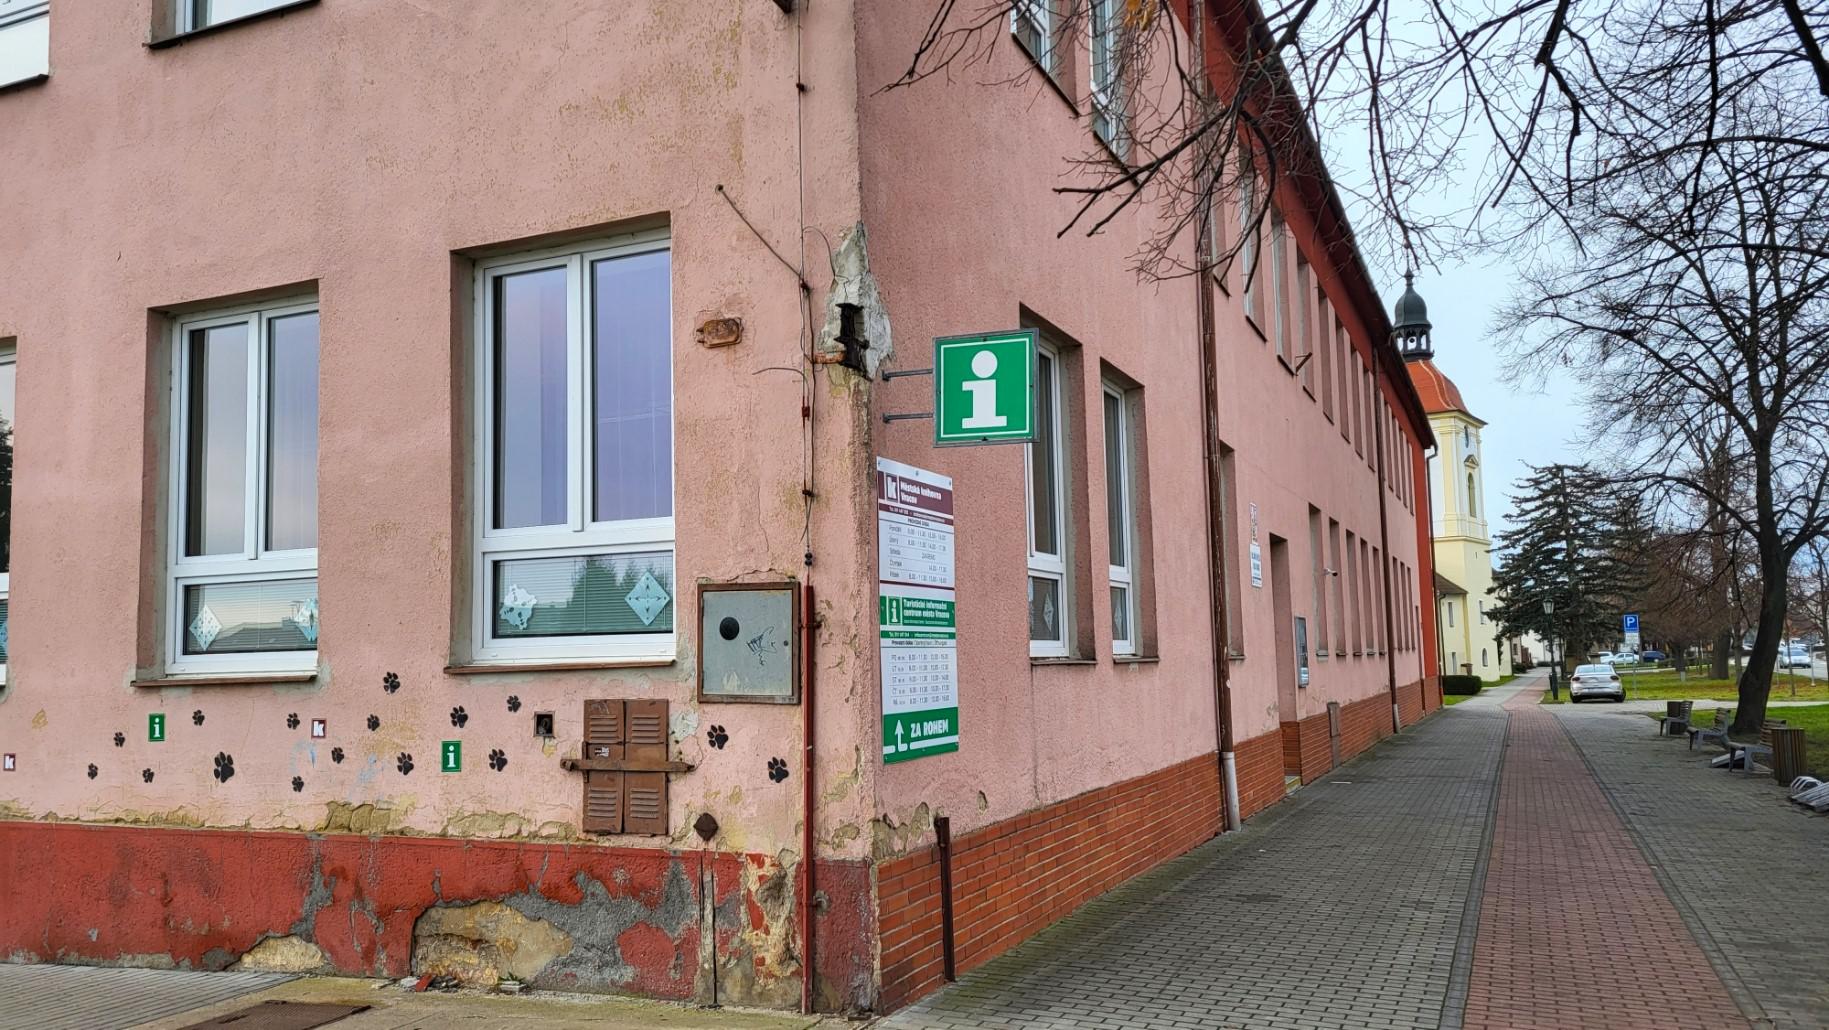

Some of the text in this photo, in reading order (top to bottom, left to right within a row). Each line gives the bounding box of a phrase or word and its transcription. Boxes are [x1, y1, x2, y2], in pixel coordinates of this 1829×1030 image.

[962, 350, 1008, 428] i
[886, 476, 896, 499] k
[900, 492, 917, 504] Vracov
[891, 600, 898, 623] i
[1627, 617, 1635, 627] P
[154, 717, 160, 737] i
[314, 721, 324, 736] k
[911, 719, 949, 738] ZA ROHEM
[447, 745, 456, 768] i
